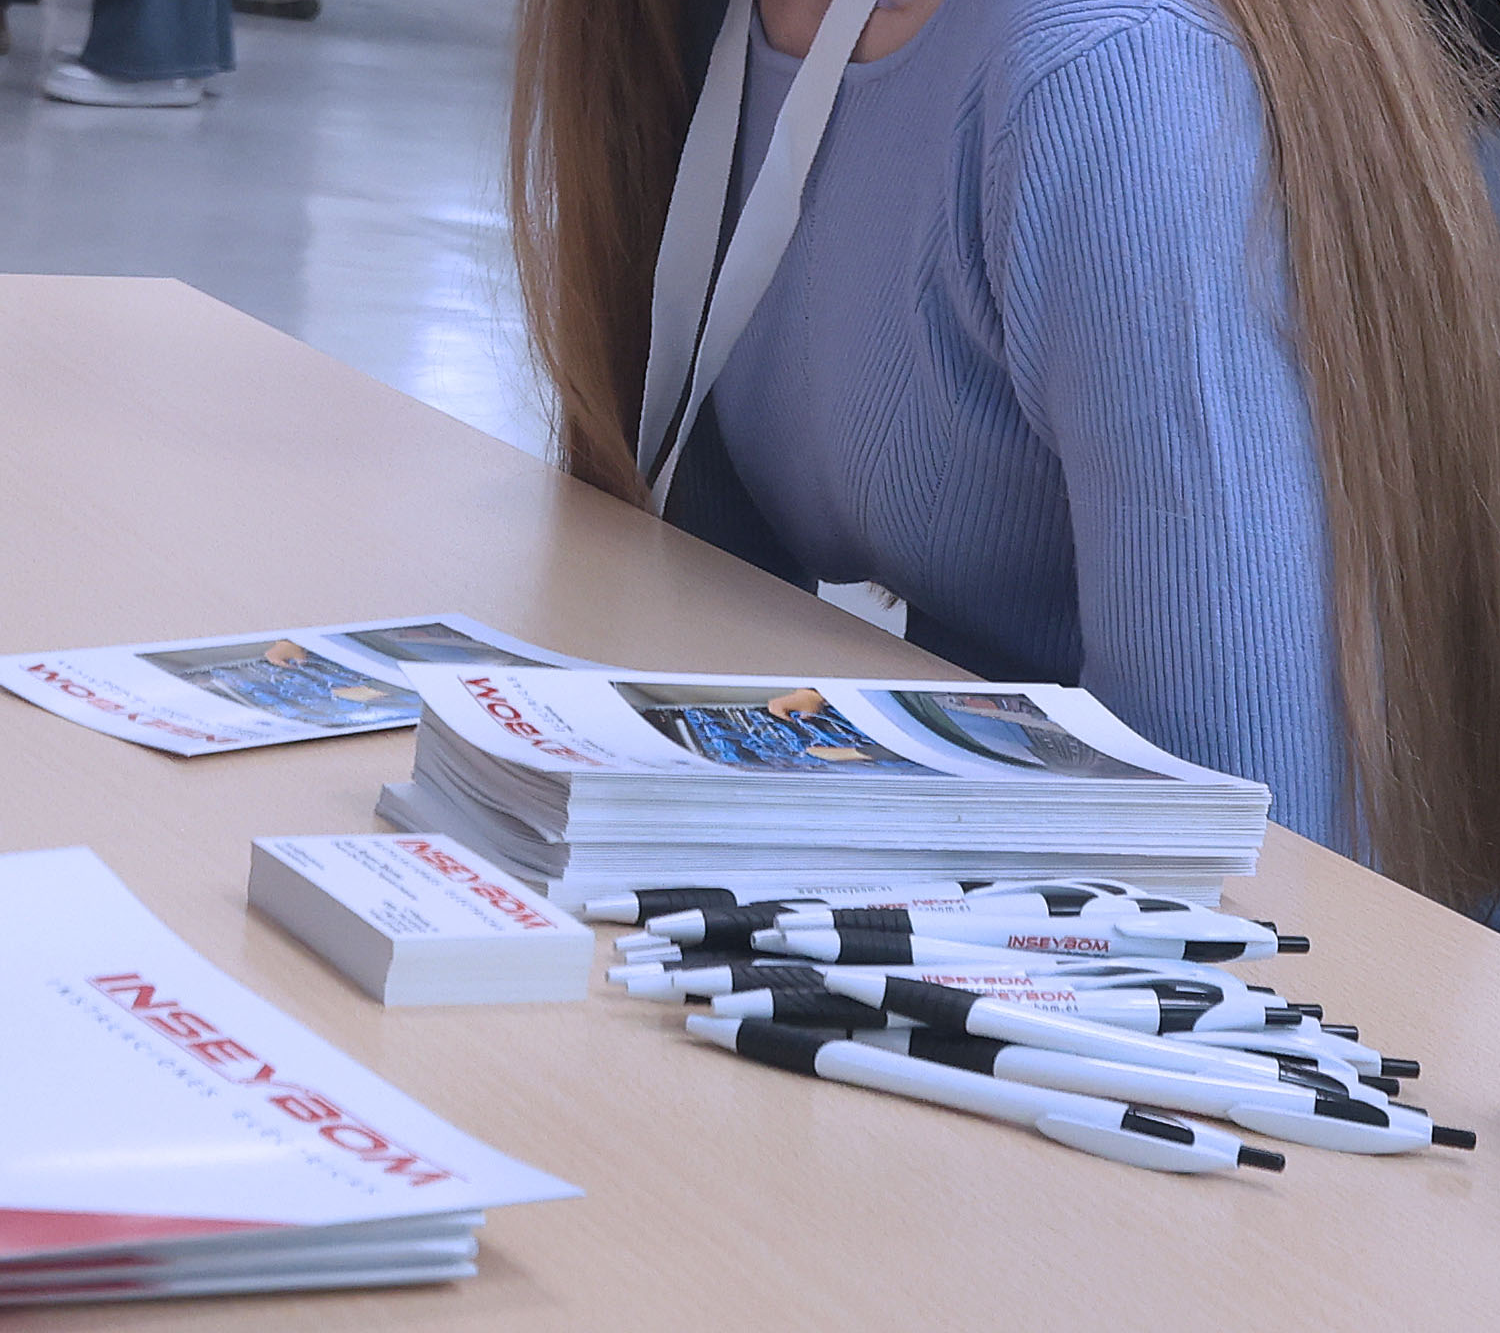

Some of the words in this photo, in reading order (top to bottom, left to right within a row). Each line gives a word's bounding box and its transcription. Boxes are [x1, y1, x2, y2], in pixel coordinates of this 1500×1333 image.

[392, 838, 556, 930] INSEYBOM
[1007, 934, 1110, 953] INSEYBOM
[921, 972, 1034, 987] INSEYBOM
[88, 971, 458, 1188] INSEYBOM
